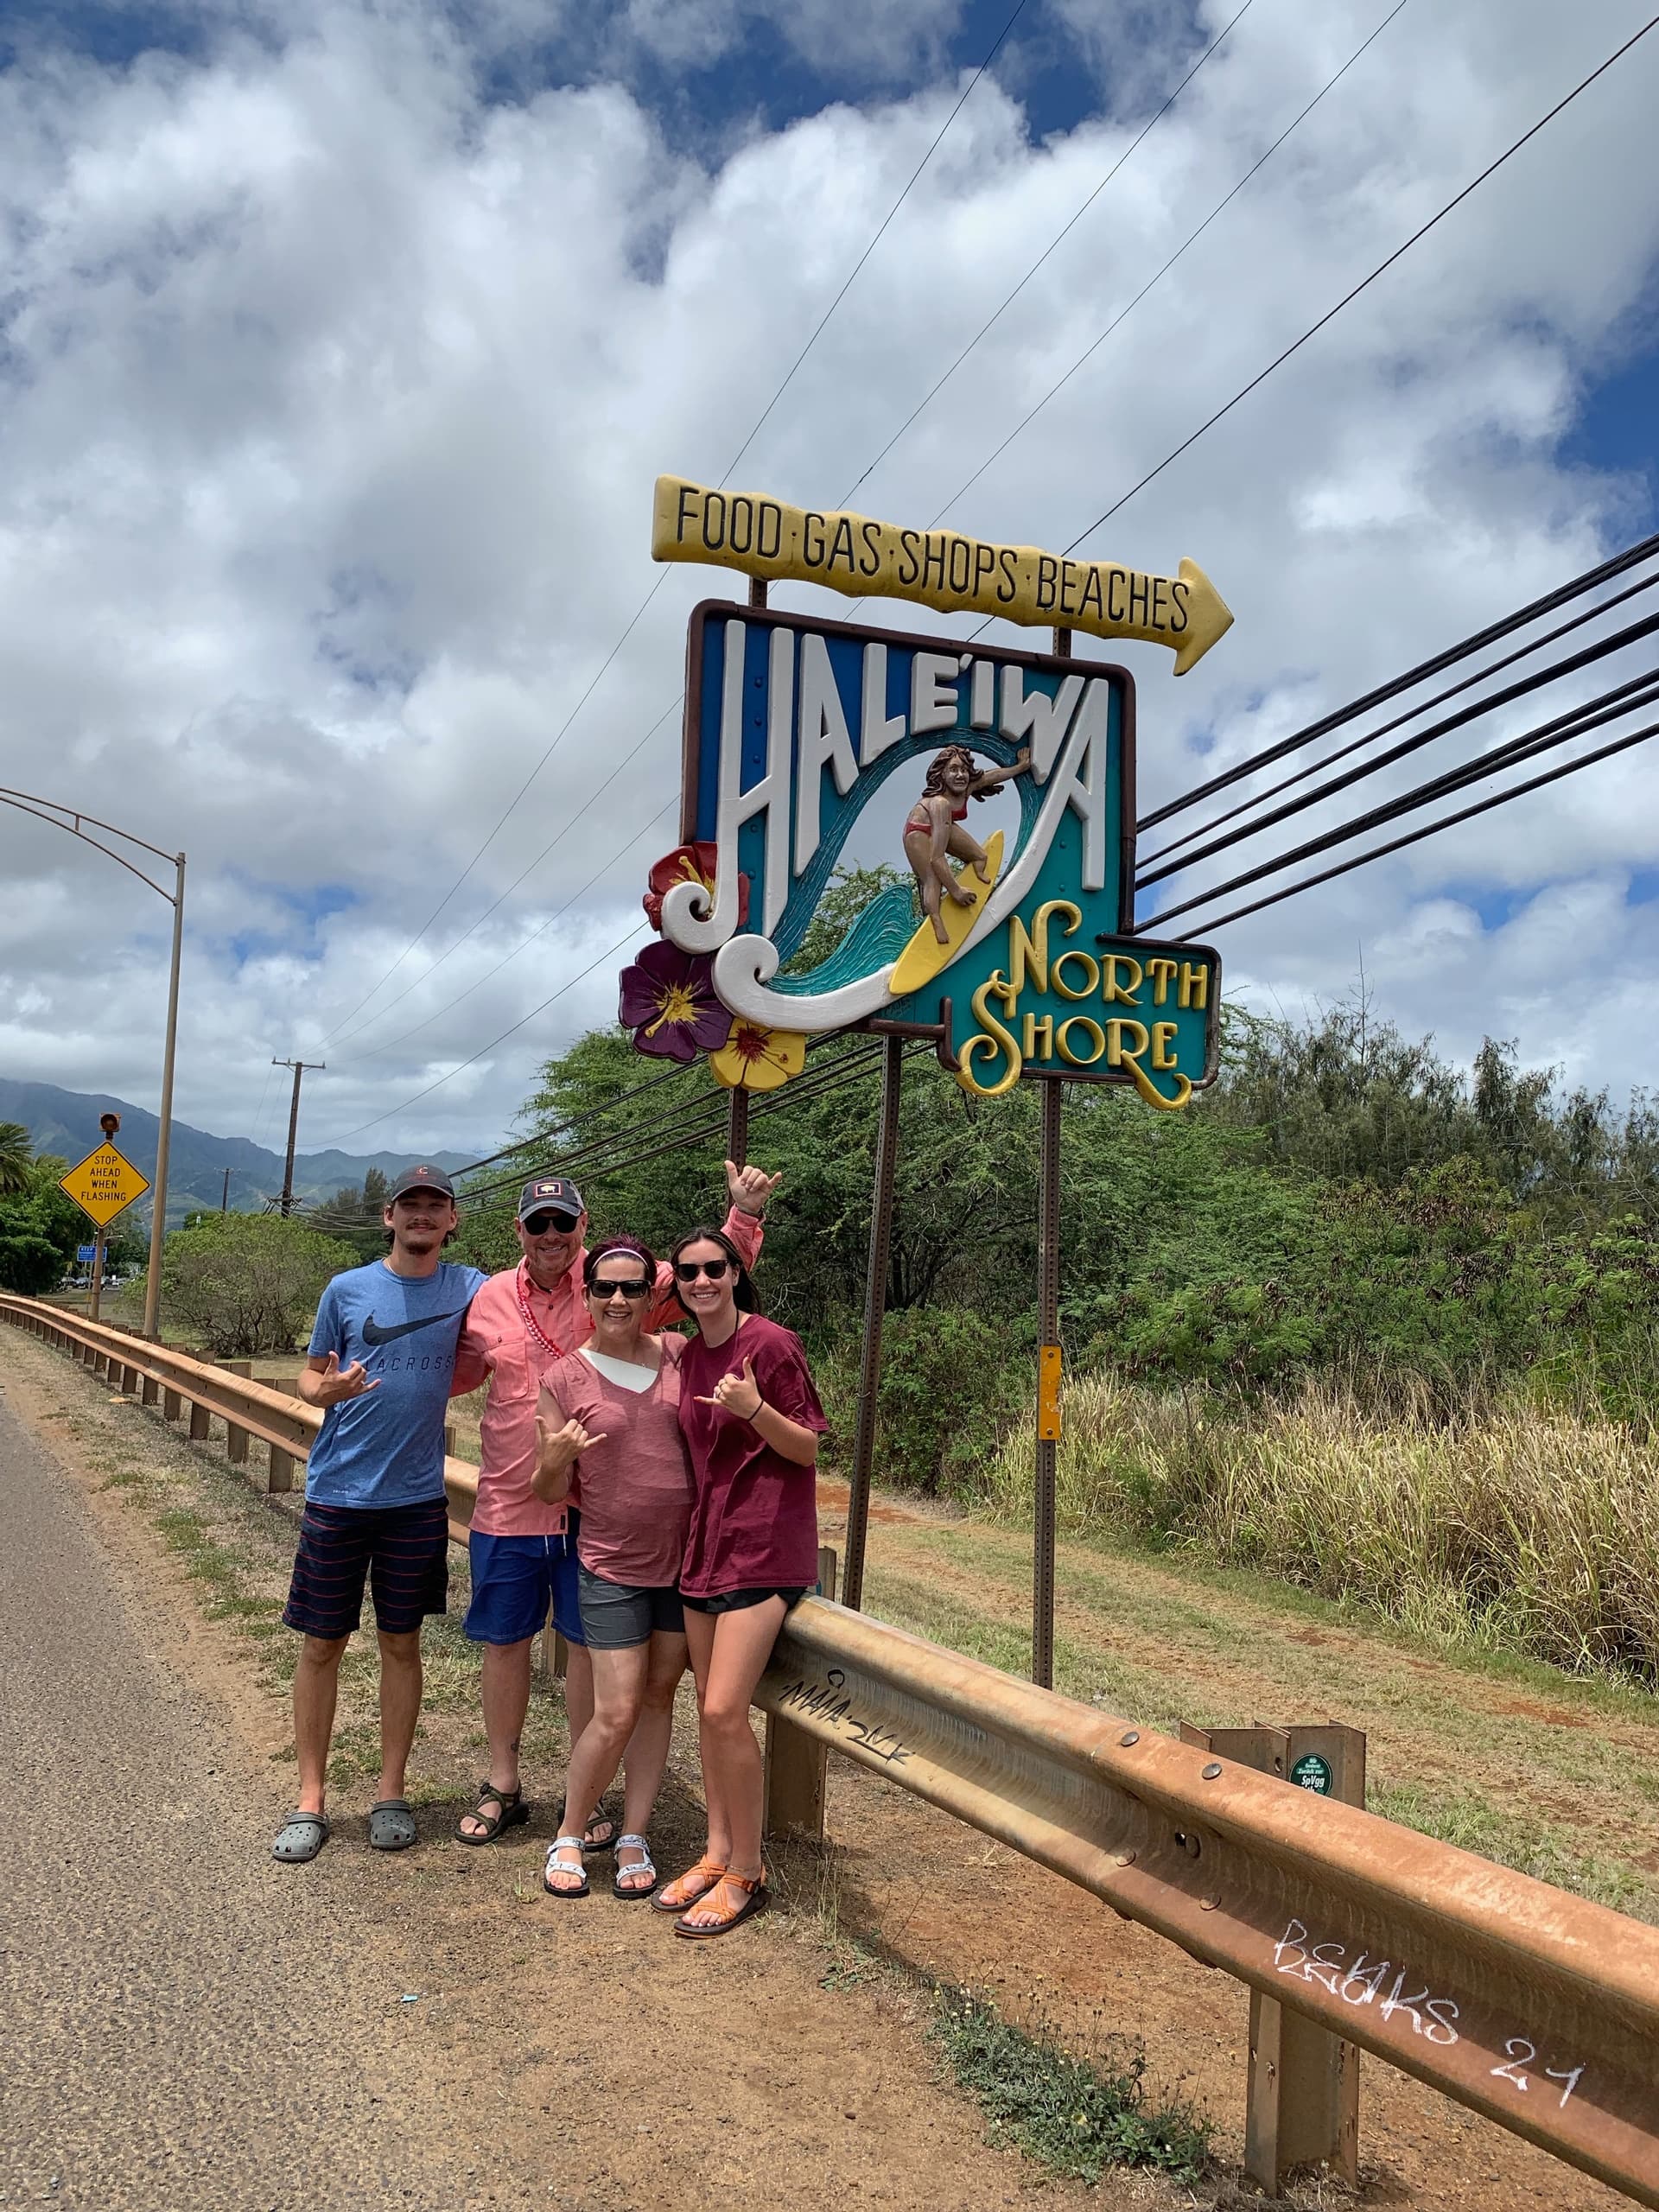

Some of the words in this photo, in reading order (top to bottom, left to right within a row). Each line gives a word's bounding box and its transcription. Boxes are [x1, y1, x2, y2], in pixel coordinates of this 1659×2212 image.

[676, 486, 781, 559] FOOD
[803, 512, 881, 576] GAS
[899, 530, 1016, 603] SHOPS
[1036, 555, 1190, 632] BEACHES
[989, 899, 1209, 1018] NORTH
[956, 978, 1192, 1111] SHORE
[94, 1155, 118, 1165] STOP
[90, 1167, 121, 1177] AHEAD
[92, 1179, 118, 1189] WHEN
[80, 1192, 127, 1202] FLASHING
[365, 1355, 454, 1372] LACROSS
[1301, 1775, 1325, 1788] SpVgg
